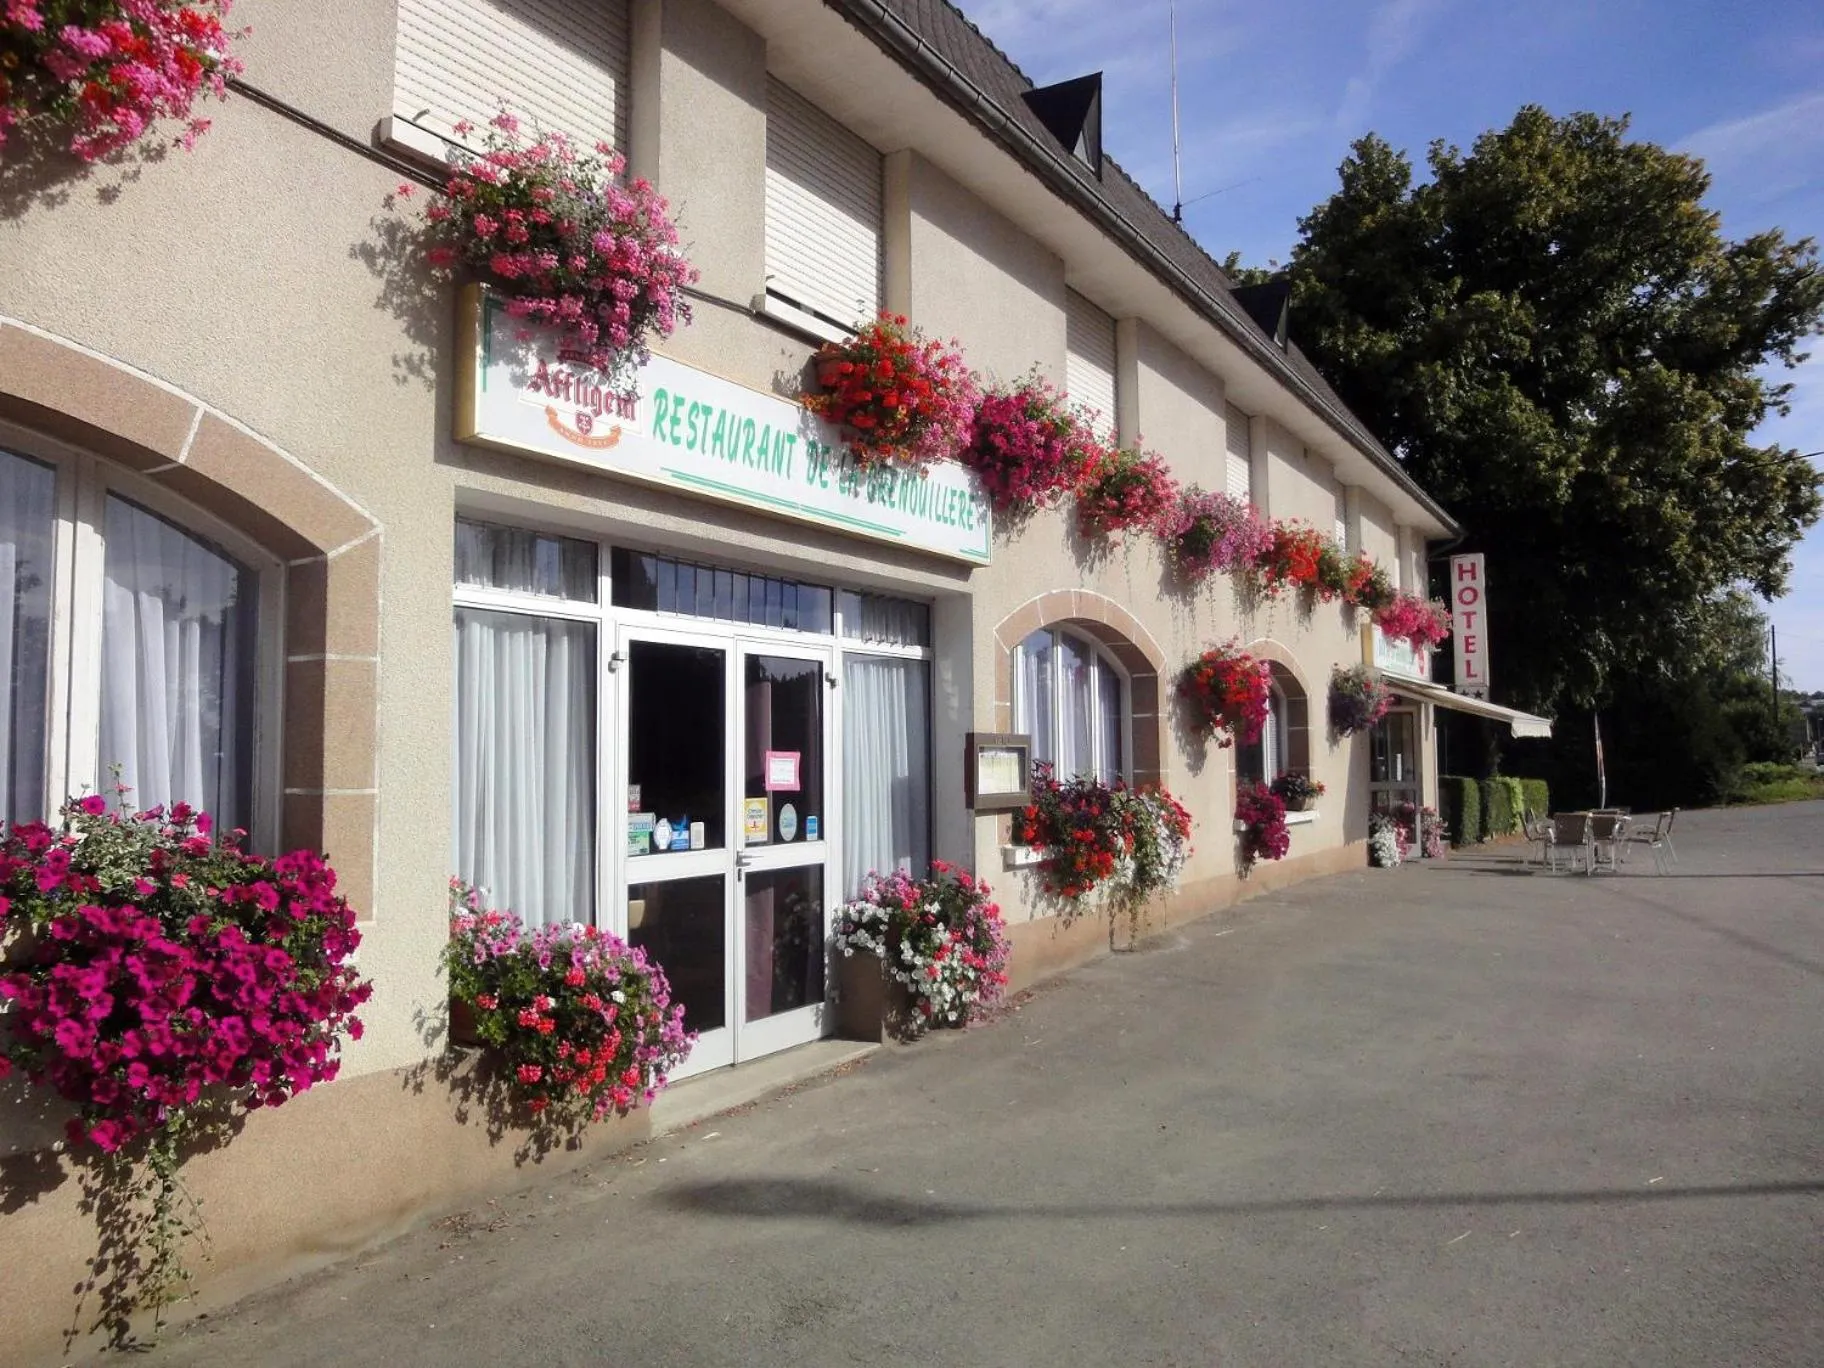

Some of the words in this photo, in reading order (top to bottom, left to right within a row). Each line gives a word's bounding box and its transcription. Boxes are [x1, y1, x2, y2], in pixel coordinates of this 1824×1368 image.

[527, 359, 641, 421] Affligem
[653, 387, 797, 480] RESTAURANT
[807, 439, 830, 489] DE
[1457, 562, 1479, 679] HOTEL
